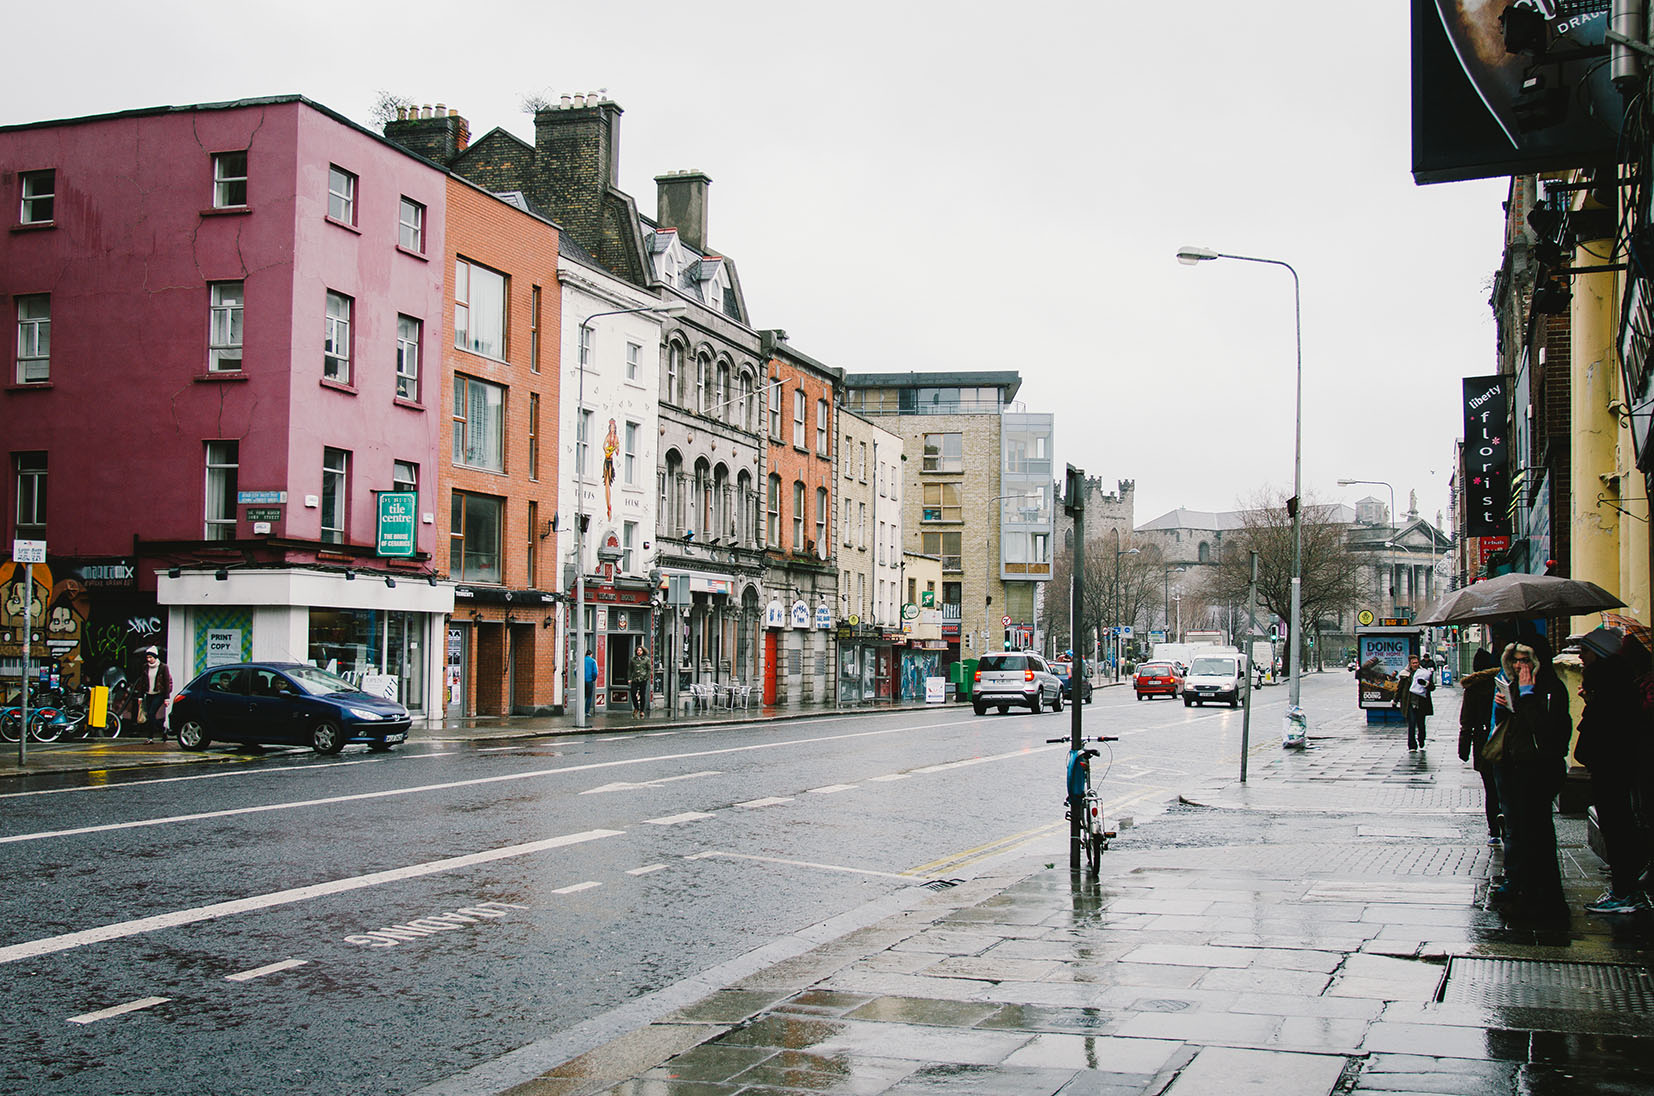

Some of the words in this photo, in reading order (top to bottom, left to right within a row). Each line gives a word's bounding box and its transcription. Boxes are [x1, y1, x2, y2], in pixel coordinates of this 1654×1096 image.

[1556, 10, 1607, 34] DRAU
[1468, 384, 1501, 409] liberty
[1479, 411, 1494, 522] florist
[382, 514, 412, 523] centre
[389, 503, 405, 513] tile
[1367, 641, 1403, 652] DOING
[344, 901, 529, 947] LOADING
